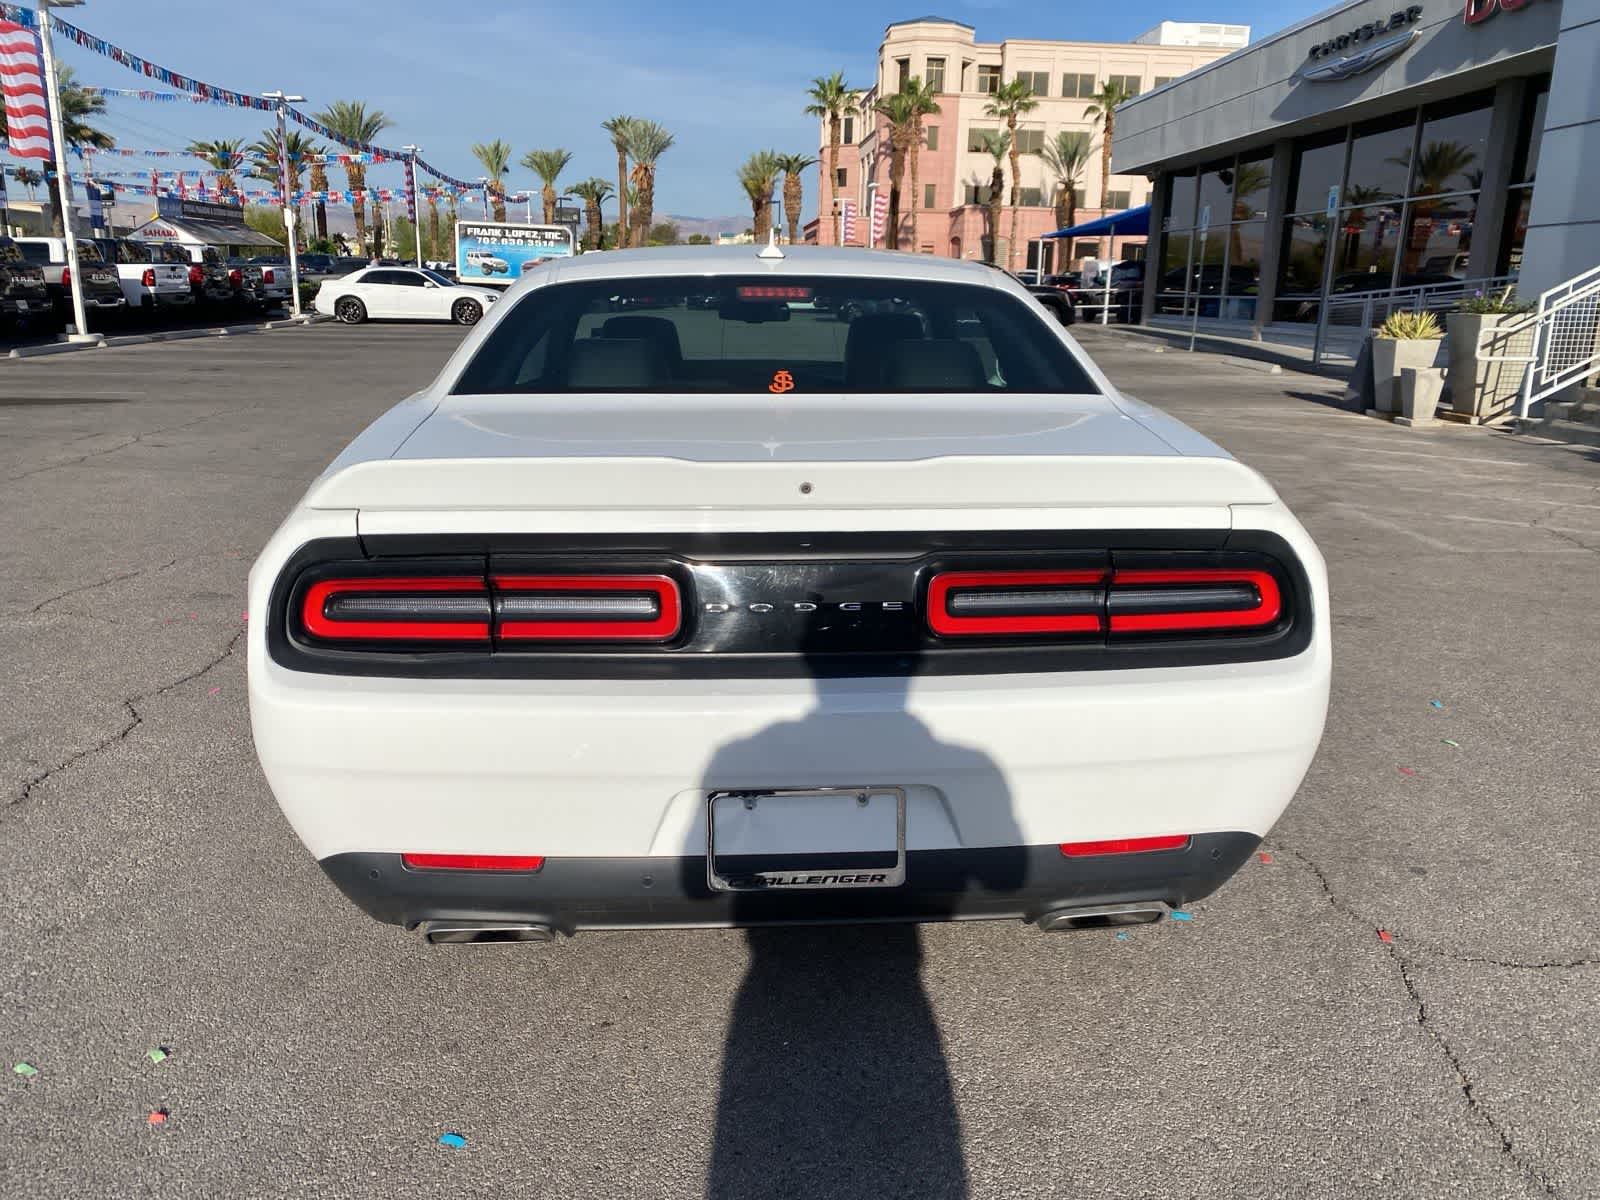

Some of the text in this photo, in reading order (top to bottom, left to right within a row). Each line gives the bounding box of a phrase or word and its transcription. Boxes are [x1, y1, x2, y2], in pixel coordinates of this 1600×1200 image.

[1463, 0, 1527, 25] D
[1309, 5, 1424, 59] CHRYSLER
[143, 229, 178, 237] SAHARA
[467, 227, 502, 237] FRANK
[505, 229, 541, 239] LOPEZ,
[704, 600, 904, 613] DODGE
